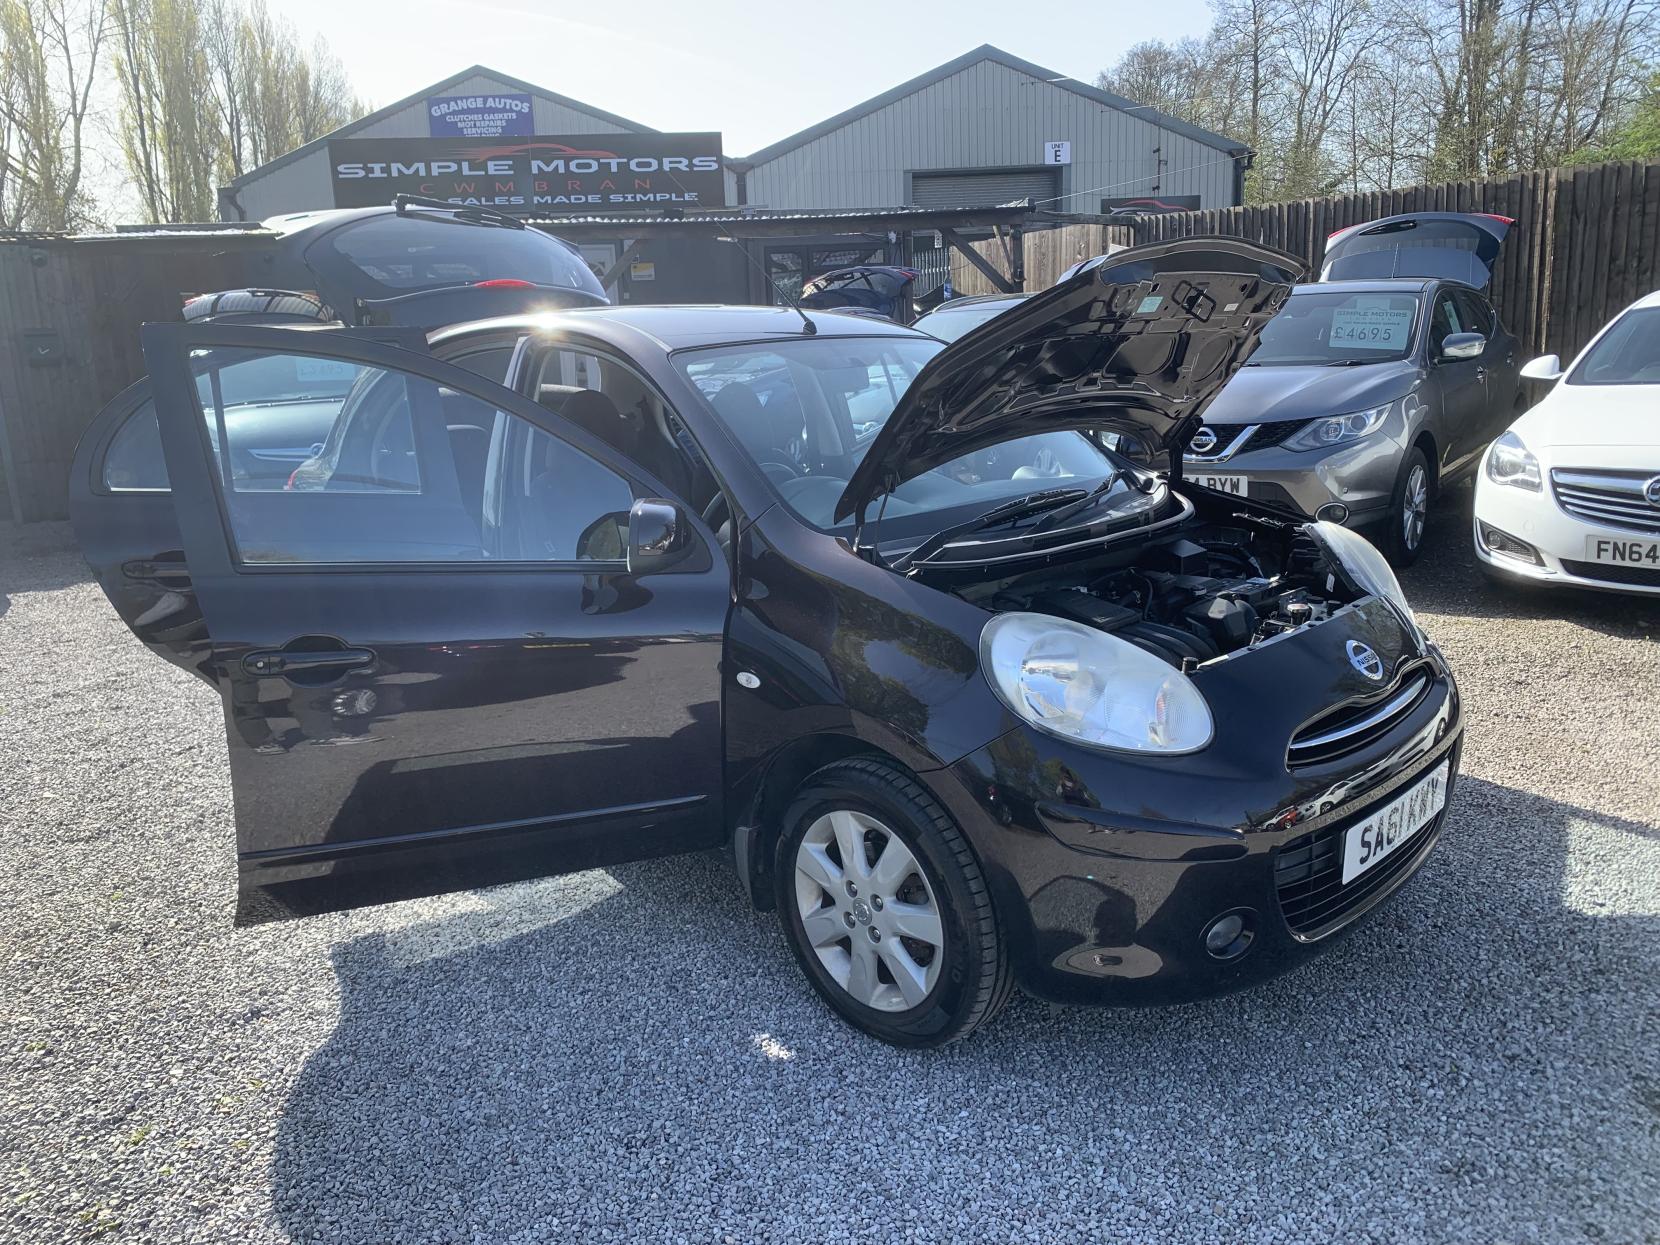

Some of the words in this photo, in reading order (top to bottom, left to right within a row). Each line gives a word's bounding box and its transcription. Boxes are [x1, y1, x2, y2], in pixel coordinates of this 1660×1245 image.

[431, 98, 484, 116] GRANGE
[486, 97, 530, 113] AUTOS
[446, 114, 482, 122] CLUTCHES
[483, 112, 517, 120] GASKETS
[463, 127, 502, 135] SERVICING
[1054, 149, 1061, 162] E
[337, 160, 514, 178] SIMPLE
[531, 156, 719, 174] MOTORS
[420, 179, 651, 194] CWMBRAN
[447, 196, 525, 206] SALES
[533, 195, 602, 205] MADE
[609, 192, 699, 203] SIMPLE
[1335, 326, 1392, 341] £4695
[1596, 540, 1660, 564] FN64
